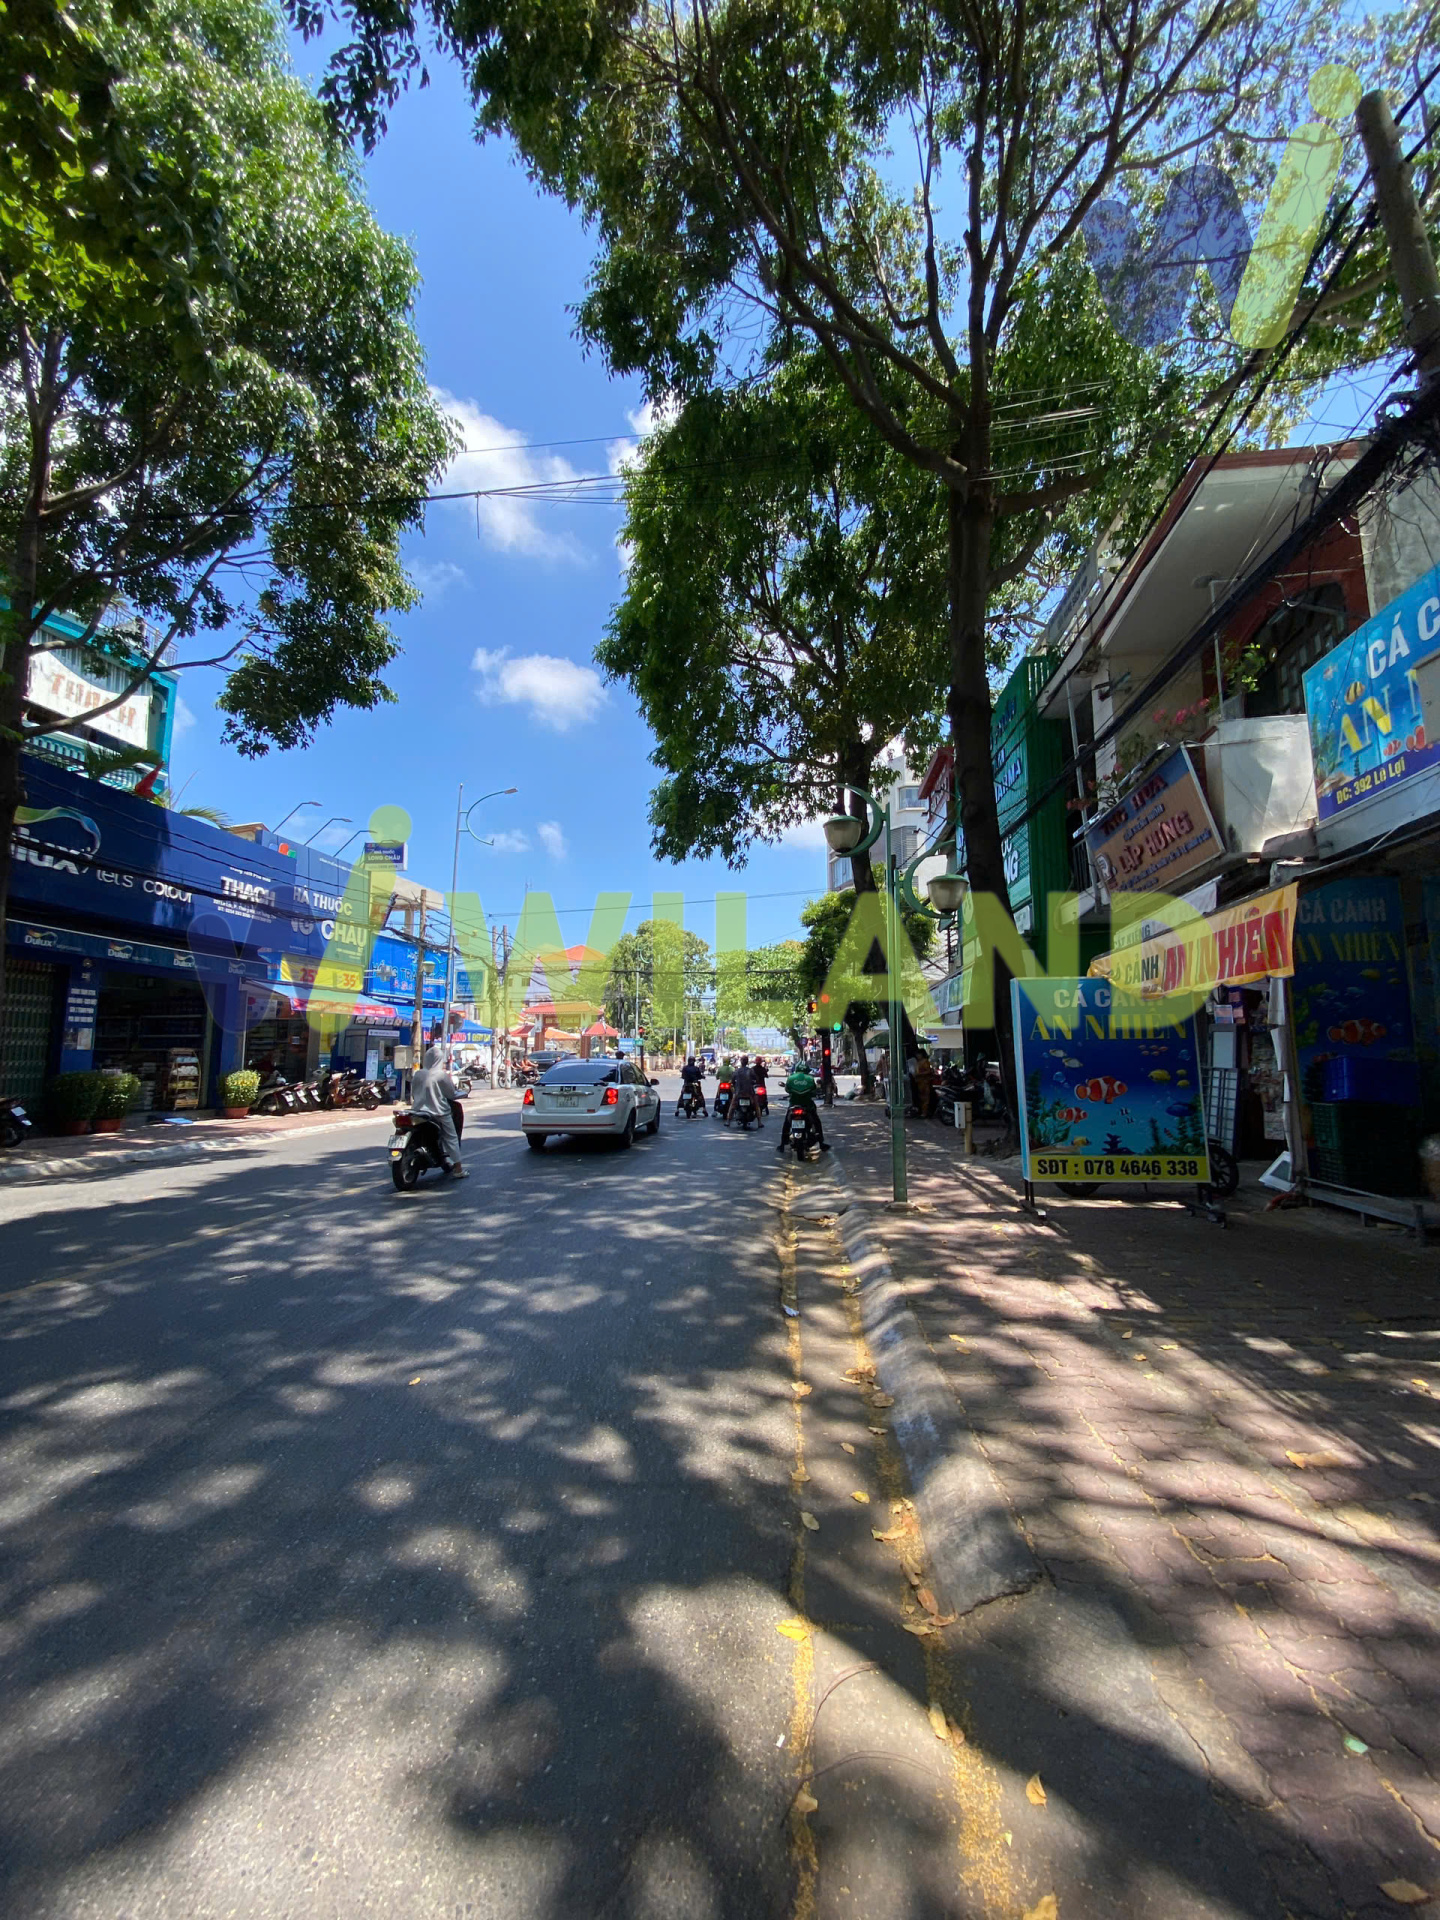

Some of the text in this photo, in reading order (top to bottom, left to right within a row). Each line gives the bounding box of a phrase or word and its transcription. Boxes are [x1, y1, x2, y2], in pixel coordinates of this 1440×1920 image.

[1366, 611, 1410, 680] CÁ
[1354, 779, 1372, 797] 392
[1125, 952, 1159, 985] CẢNH
[1054, 983, 1087, 1008] CÁ
[1030, 1008, 1187, 1041] AN NHIÊN
[1084, 1159, 1115, 1175] 078
[1120, 1160, 1161, 1176] 4646
[1167, 1160, 1198, 1176] 338
